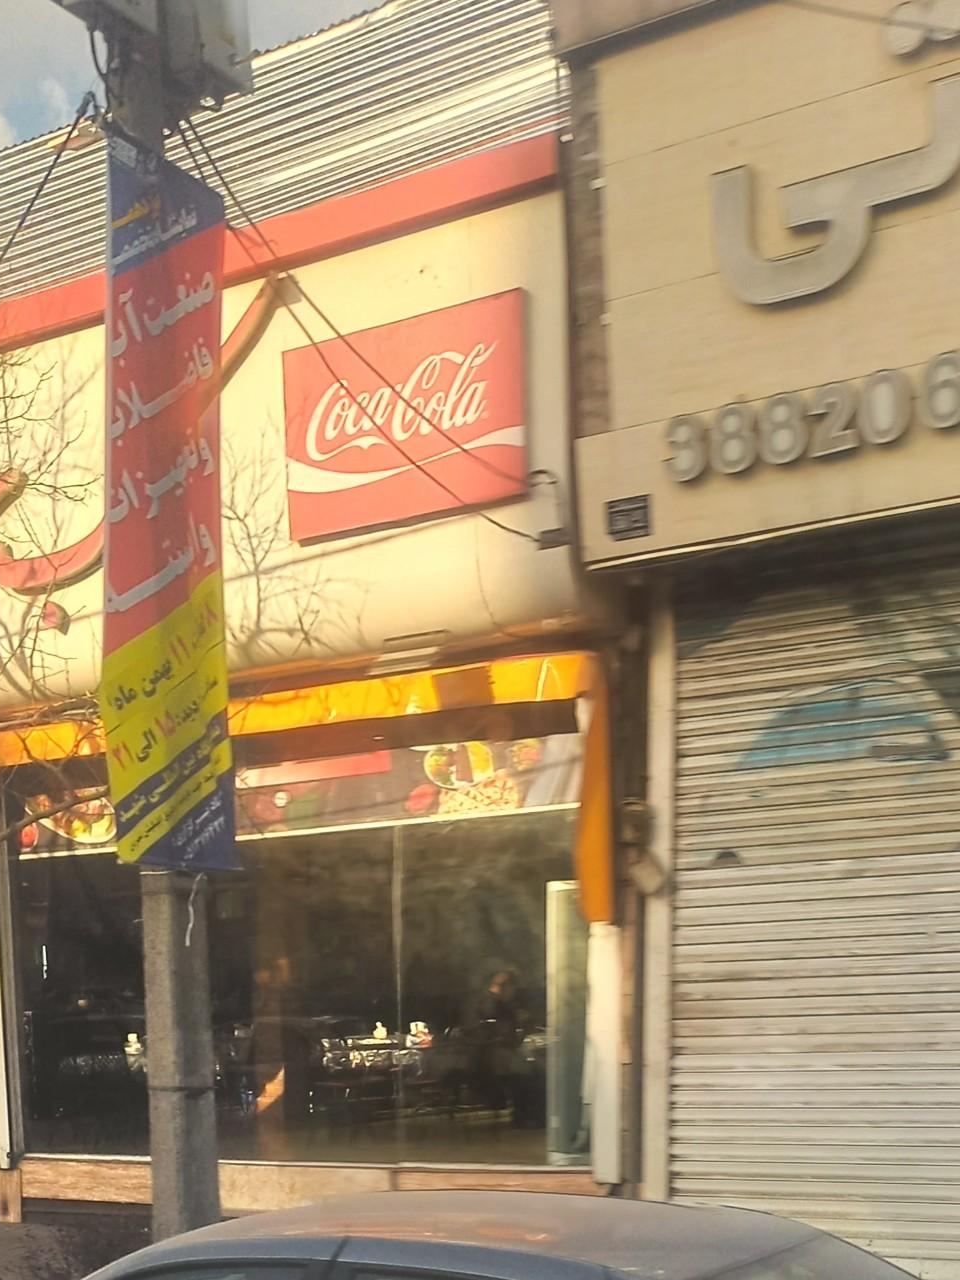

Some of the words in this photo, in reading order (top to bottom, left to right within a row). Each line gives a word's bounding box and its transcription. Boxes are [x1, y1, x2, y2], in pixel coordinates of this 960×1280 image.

[143, 271, 214, 336] صنعت
[305, 341, 497, 462] Coca-Cola
[142, 658, 174, 699] بهمن
